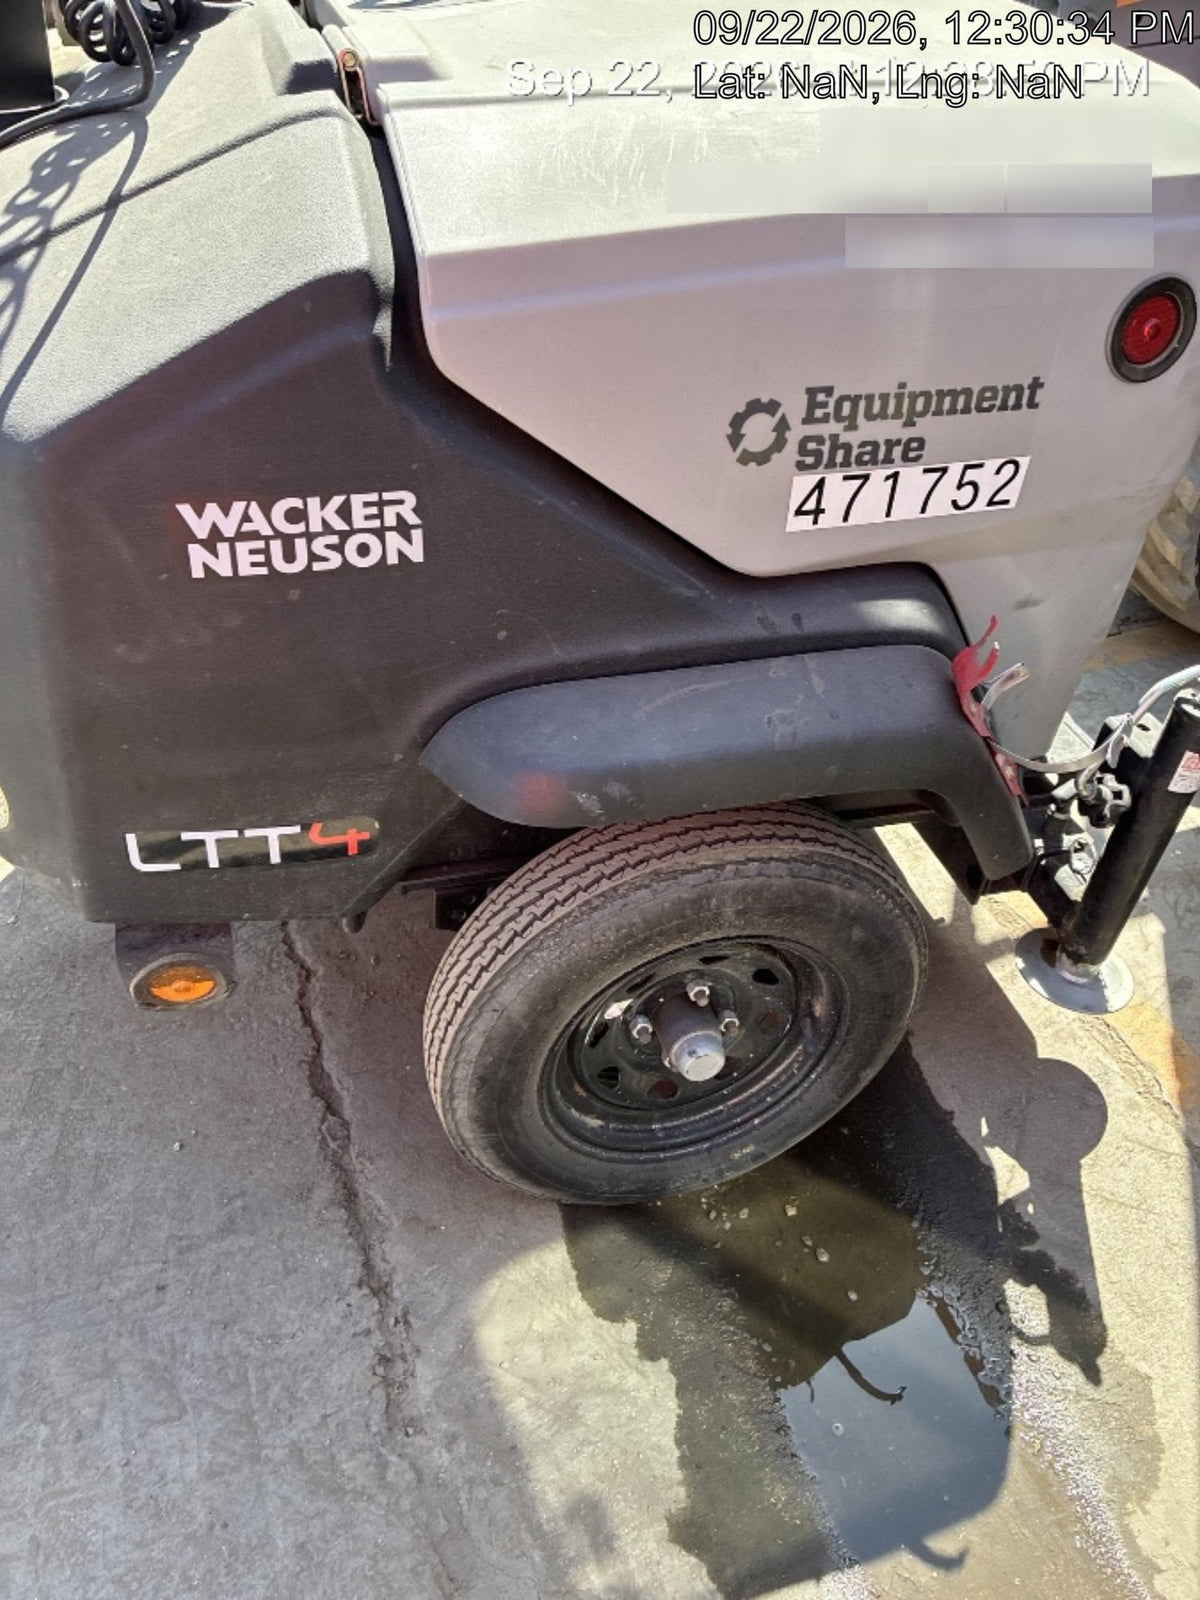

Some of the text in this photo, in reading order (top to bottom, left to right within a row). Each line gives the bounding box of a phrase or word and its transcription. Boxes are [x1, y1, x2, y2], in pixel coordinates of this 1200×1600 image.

[801, 376, 1045, 432] Equipment
[795, 432, 926, 472] Share
[175, 490, 423, 540] WACKER
[794, 458, 1021, 525] 471752
[187, 528, 425, 579] NEUSON
[125, 821, 371, 872] LTT4
